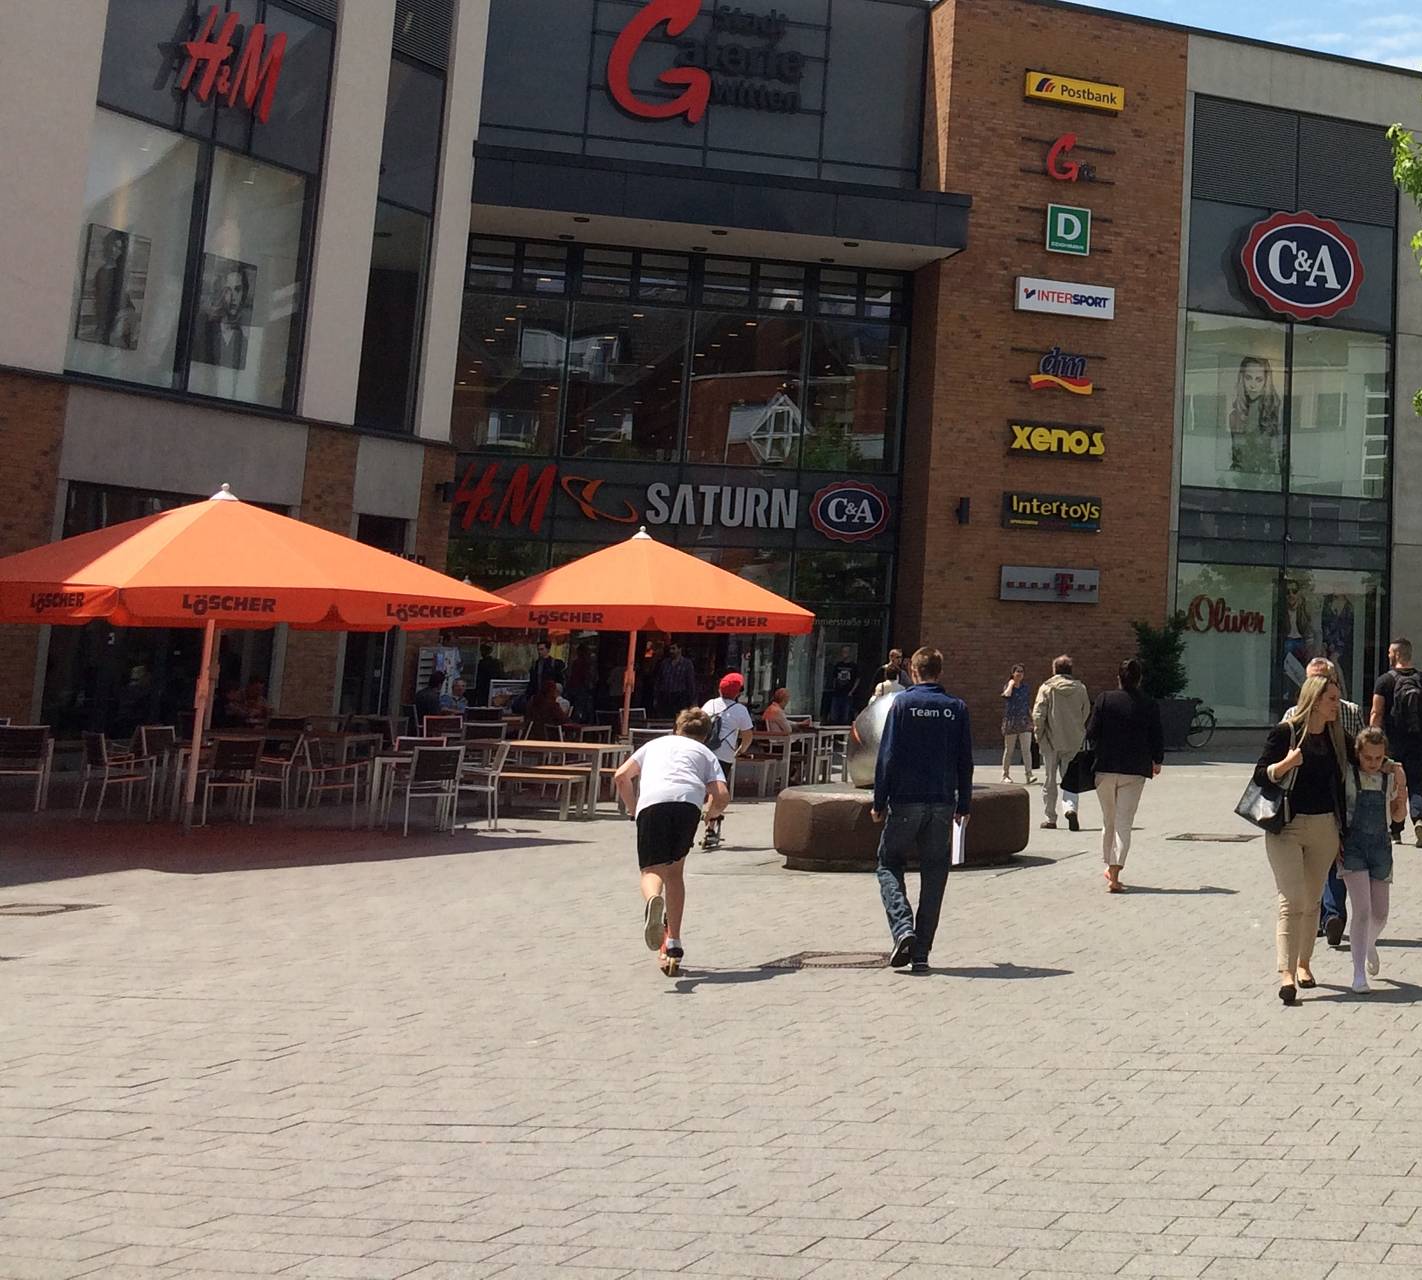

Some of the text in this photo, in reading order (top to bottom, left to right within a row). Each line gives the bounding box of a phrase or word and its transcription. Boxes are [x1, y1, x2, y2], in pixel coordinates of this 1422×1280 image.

[180, 5, 288, 124] H&M
[1060, 84, 1118, 105] Postbank
[1268, 239, 1341, 289] C&A
[1037, 289, 1111, 309] INTERSPORT
[1040, 346, 1088, 379] dm
[1011, 425, 1106, 456] xenos
[451, 463, 558, 535] H&M
[645, 482, 799, 529] SATURN
[827, 497, 876, 525] C&A
[1011, 495, 1101, 522] Intertoys
[182, 593, 277, 616] LÖSCHER
[528, 611, 604, 625] LÖSCHER
[697, 615, 768, 631] LÖSCHER
[910, 707, 940, 718] Team
